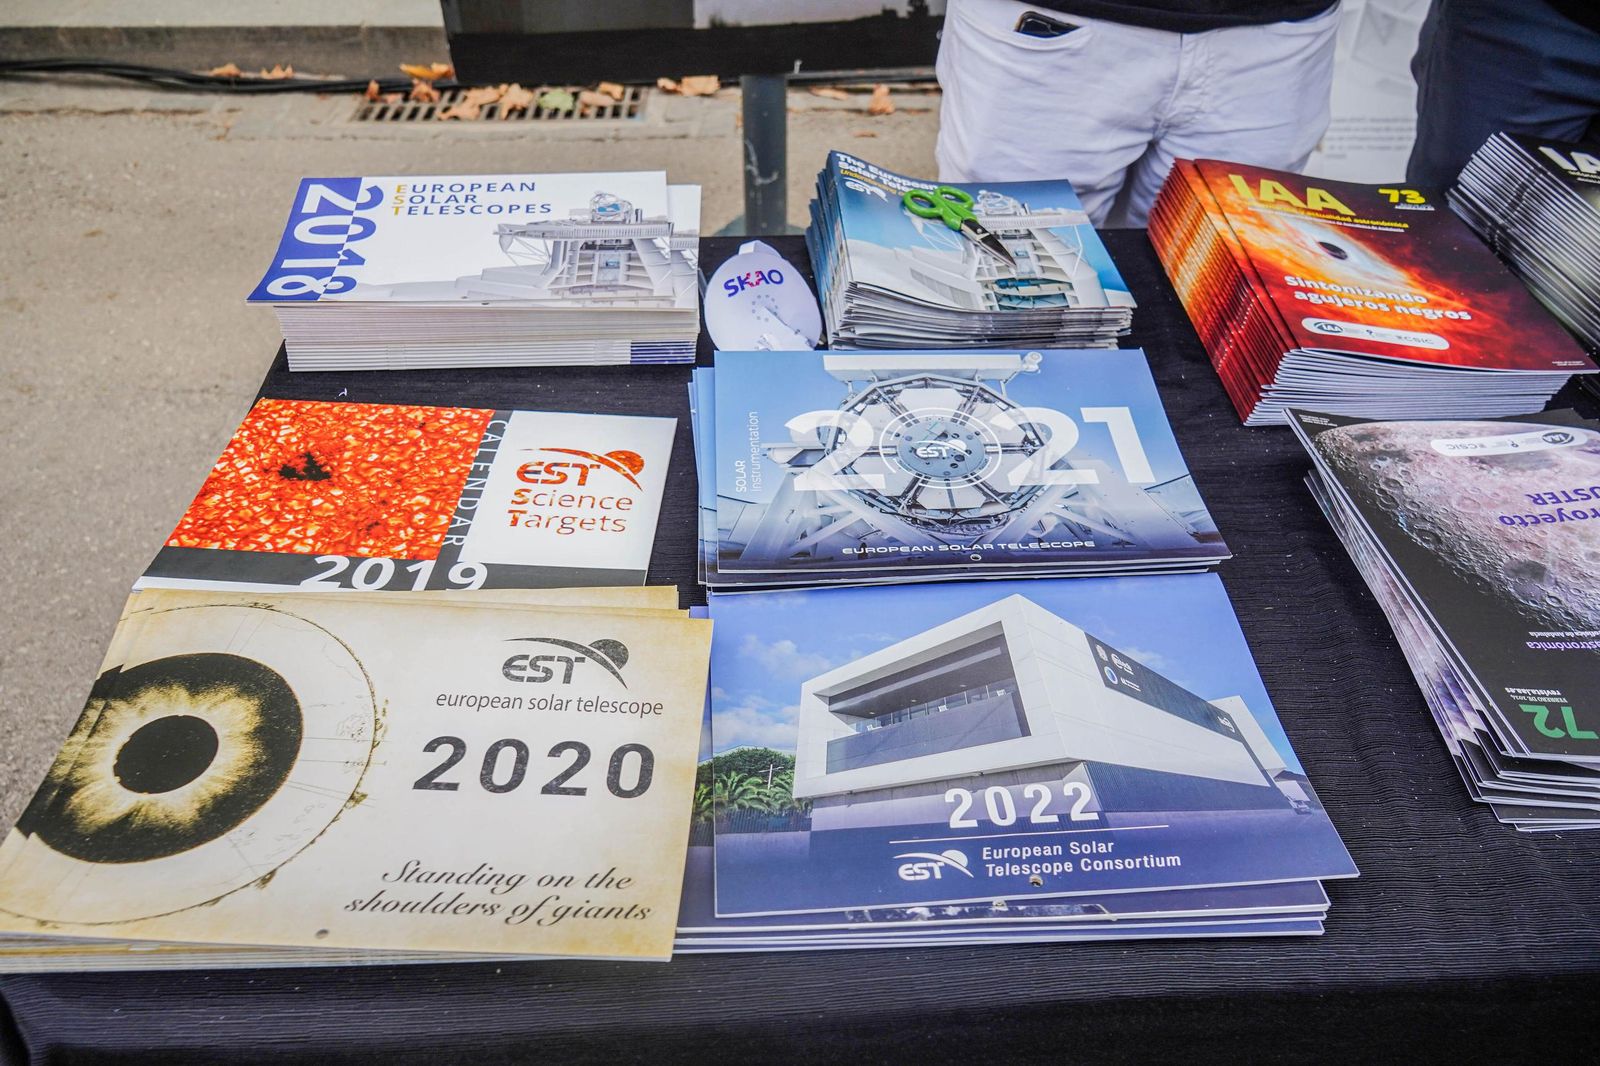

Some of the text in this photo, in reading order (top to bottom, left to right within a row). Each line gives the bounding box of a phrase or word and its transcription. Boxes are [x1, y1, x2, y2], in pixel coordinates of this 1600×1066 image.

[836, 153, 938, 190] The European
[838, 161, 877, 180] Solar
[393, 194, 478, 205] SOLAR
[396, 182, 536, 194] EUROPEAN
[1228, 174, 1356, 216] IAA
[1378, 188, 1425, 204] 73
[391, 203, 552, 216] TELESCOPES
[266, 184, 384, 296] 2018
[723, 269, 784, 298] SKAO
[1284, 275, 1428, 304] Sintonizando
[1294, 290, 1472, 320] agujeros negros
[748, 411, 762, 492] Instrumentation
[916, 446, 950, 458] EST
[443, 420, 508, 546] CALENDAR
[516, 461, 601, 486] EST
[735, 460, 746, 493] SOLAR
[511, 488, 633, 511] Science
[1525, 486, 1600, 506] USTER
[507, 509, 627, 535] Targets
[1499, 507, 1600, 528] royecto
[842, 541, 1096, 555] EUROPEAN SOLAR TELESCOPE
[300, 555, 488, 592] 2019
[501, 654, 586, 684] EST
[436, 693, 664, 719] european solar telescope
[1518, 704, 1600, 740] 72
[412, 735, 655, 799] 2020
[944, 782, 1099, 829] 2022
[982, 839, 1115, 861] European Solar
[381, 860, 633, 895] Standing on the
[898, 862, 945, 881] EST
[985, 853, 1182, 877] Telescope Consortium
[344, 890, 652, 926] shoulders of giants
